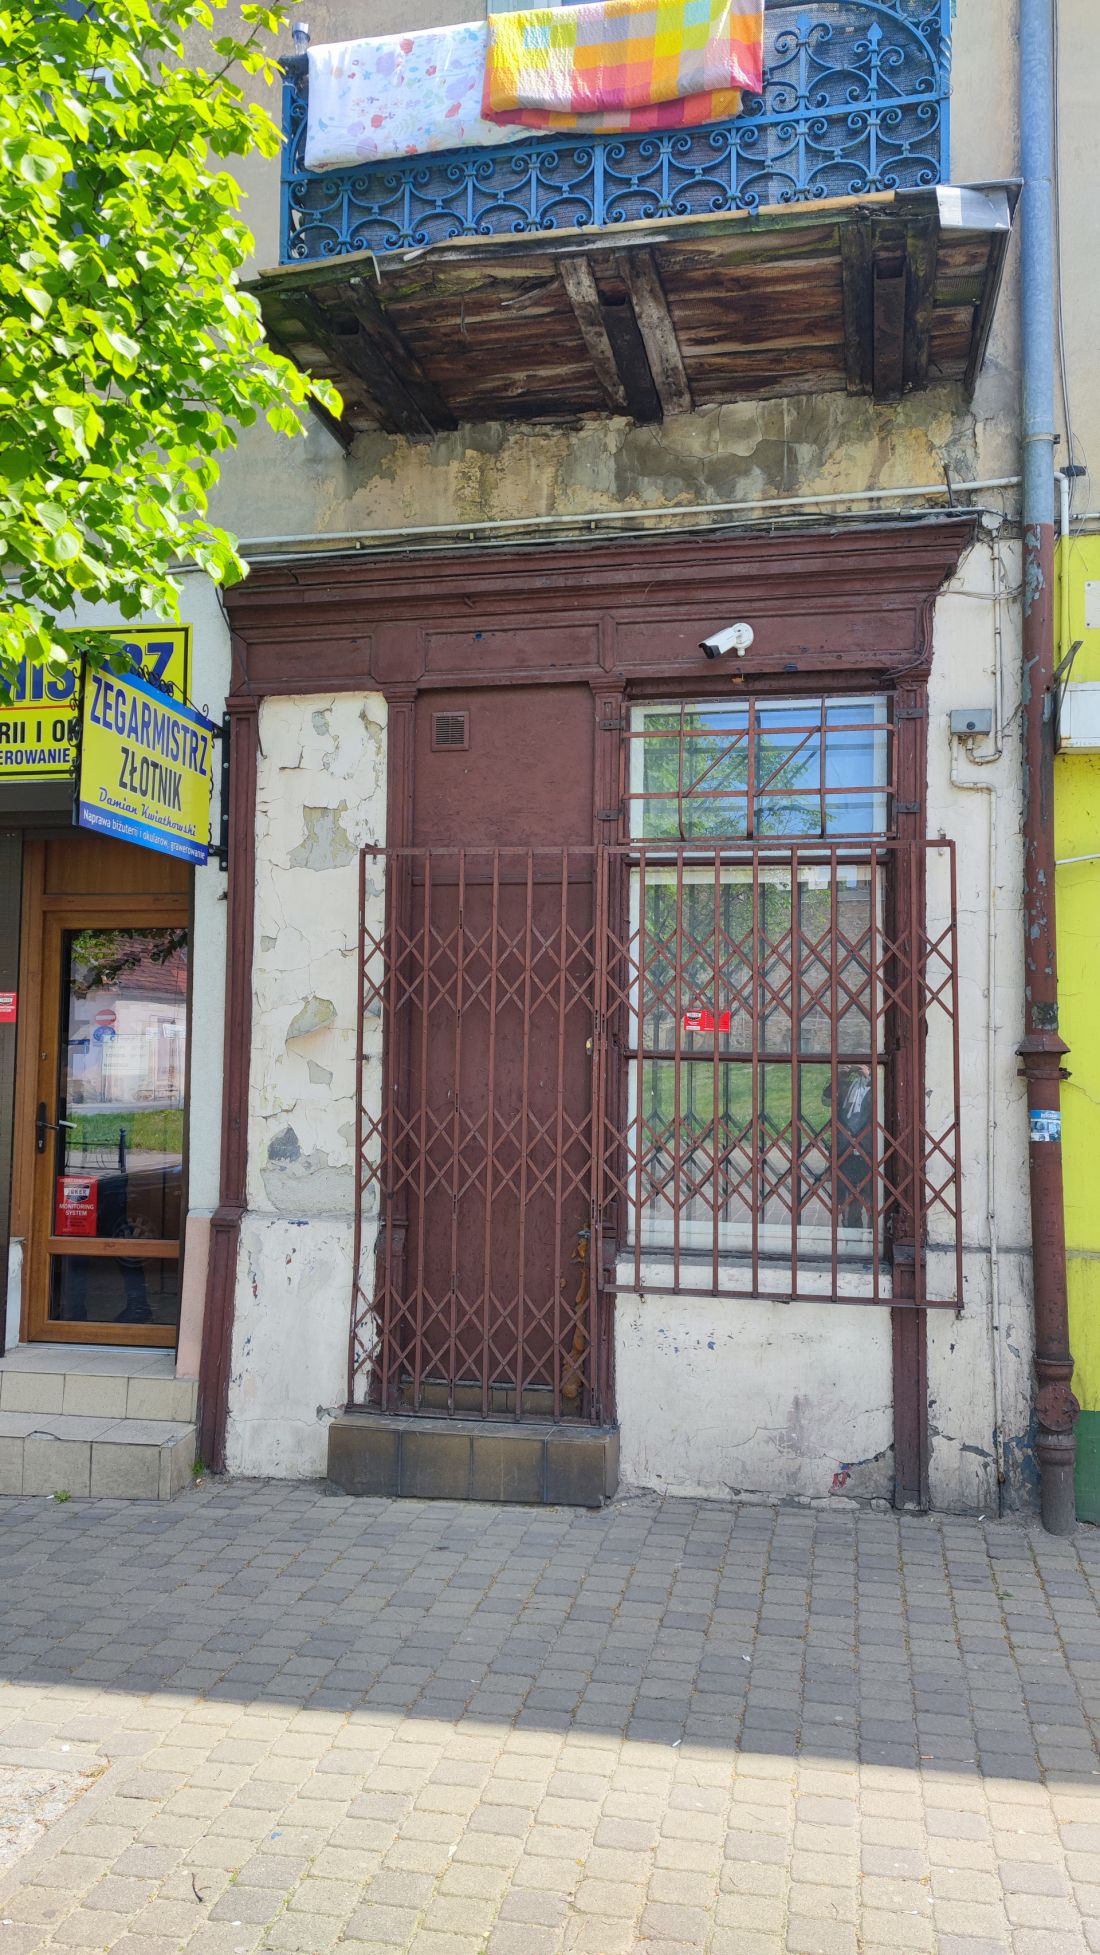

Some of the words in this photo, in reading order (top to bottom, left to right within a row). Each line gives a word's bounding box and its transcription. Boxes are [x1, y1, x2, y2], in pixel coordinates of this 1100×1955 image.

[36, 720, 42, 743] I
[90, 674, 208, 777] ZEGARMISTRZ
[119, 745, 182, 812] ZŁOTNIK
[83, 808, 111, 828] Naprawa
[99, 786, 138, 815] Damian
[141, 803, 197, 837] Kwiatkowski
